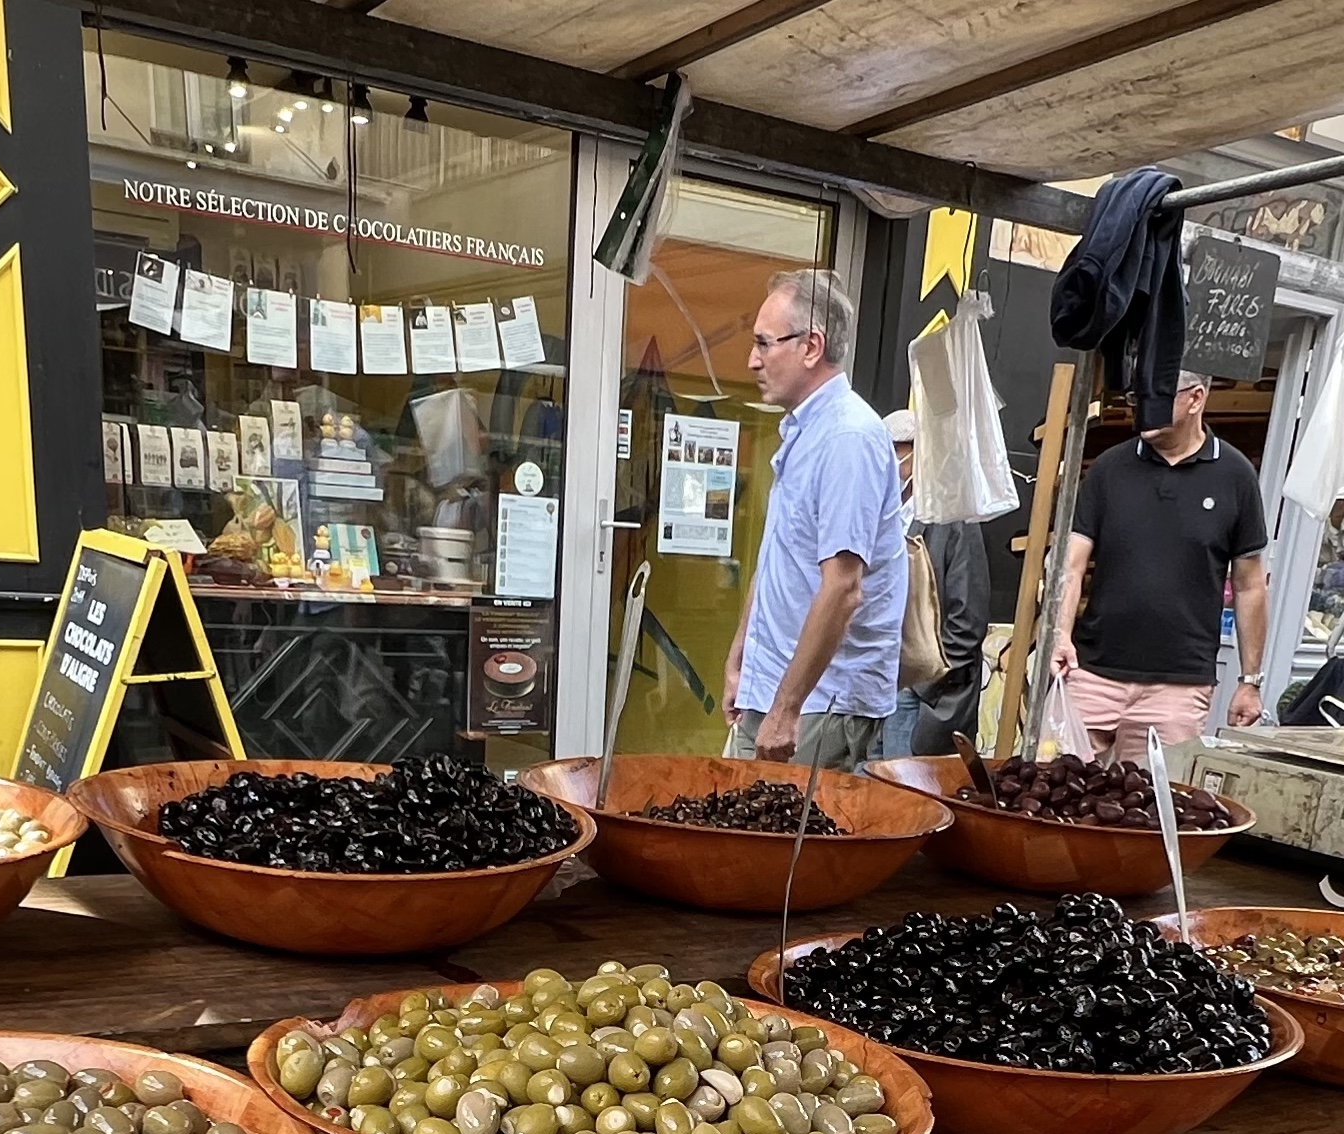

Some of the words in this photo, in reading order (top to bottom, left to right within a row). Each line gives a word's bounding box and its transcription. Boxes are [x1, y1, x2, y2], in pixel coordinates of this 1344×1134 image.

[123, 178, 192, 208] NOTRE
[196, 188, 300, 226] SÉLECTION
[304, 208, 329, 231] DE
[466, 236, 545, 266] FRANÇAIS
[86, 599, 108, 626] LES
[64, 621, 116, 666] CHOCOLATS
